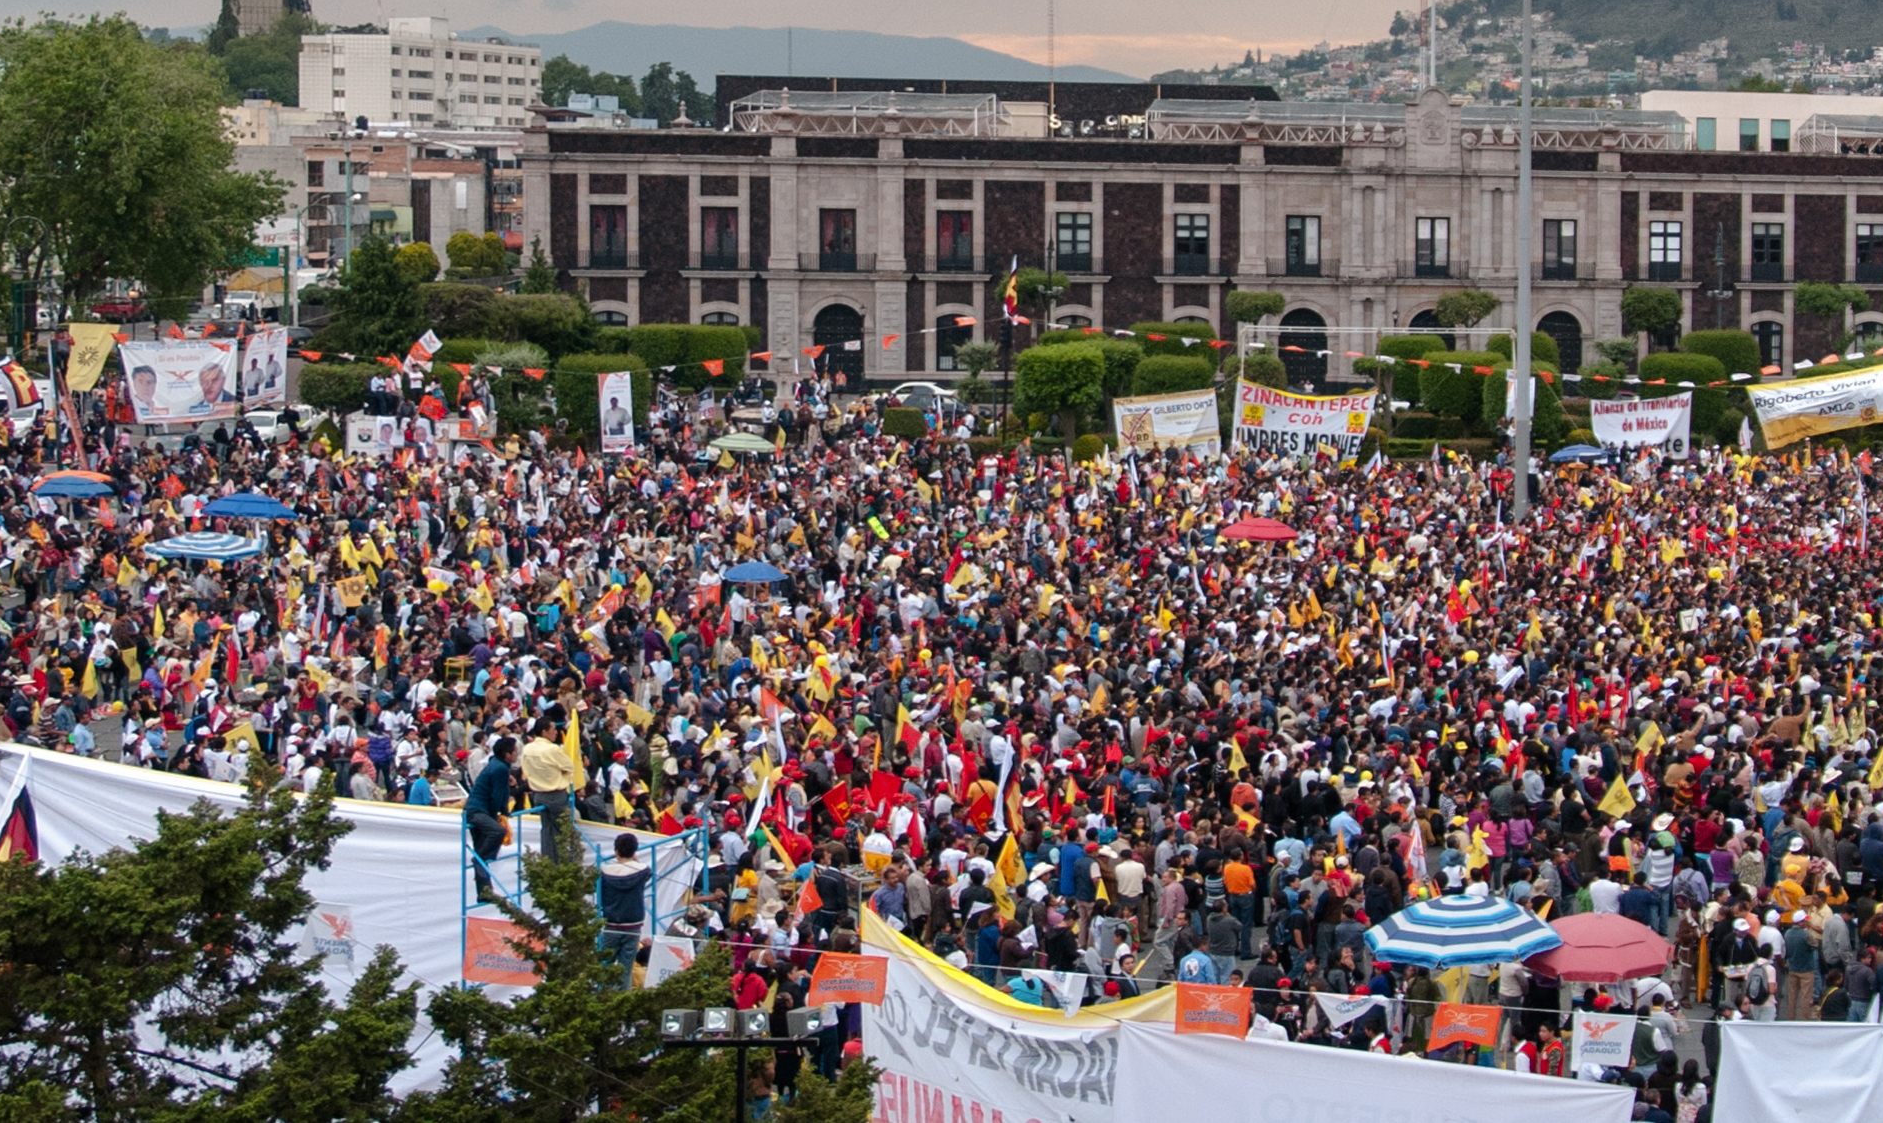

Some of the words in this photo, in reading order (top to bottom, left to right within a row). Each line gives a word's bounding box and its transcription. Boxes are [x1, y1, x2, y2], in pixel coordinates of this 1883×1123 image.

[1241, 385, 1370, 412] ZINACANTEPEC
[1755, 388, 1825, 409] Rigoberto
[1831, 378, 1876, 392] Vivian
[1153, 403, 1193, 415] GILBERTO
[1594, 402, 1624, 416] Alianza
[1628, 401, 1638, 412] de
[1642, 396, 1689, 411] Tranviarios
[1819, 402, 1855, 416] AMLO
[1288, 412, 1324, 425] con
[1622, 418, 1633, 432] de
[1636, 416, 1668, 431] México
